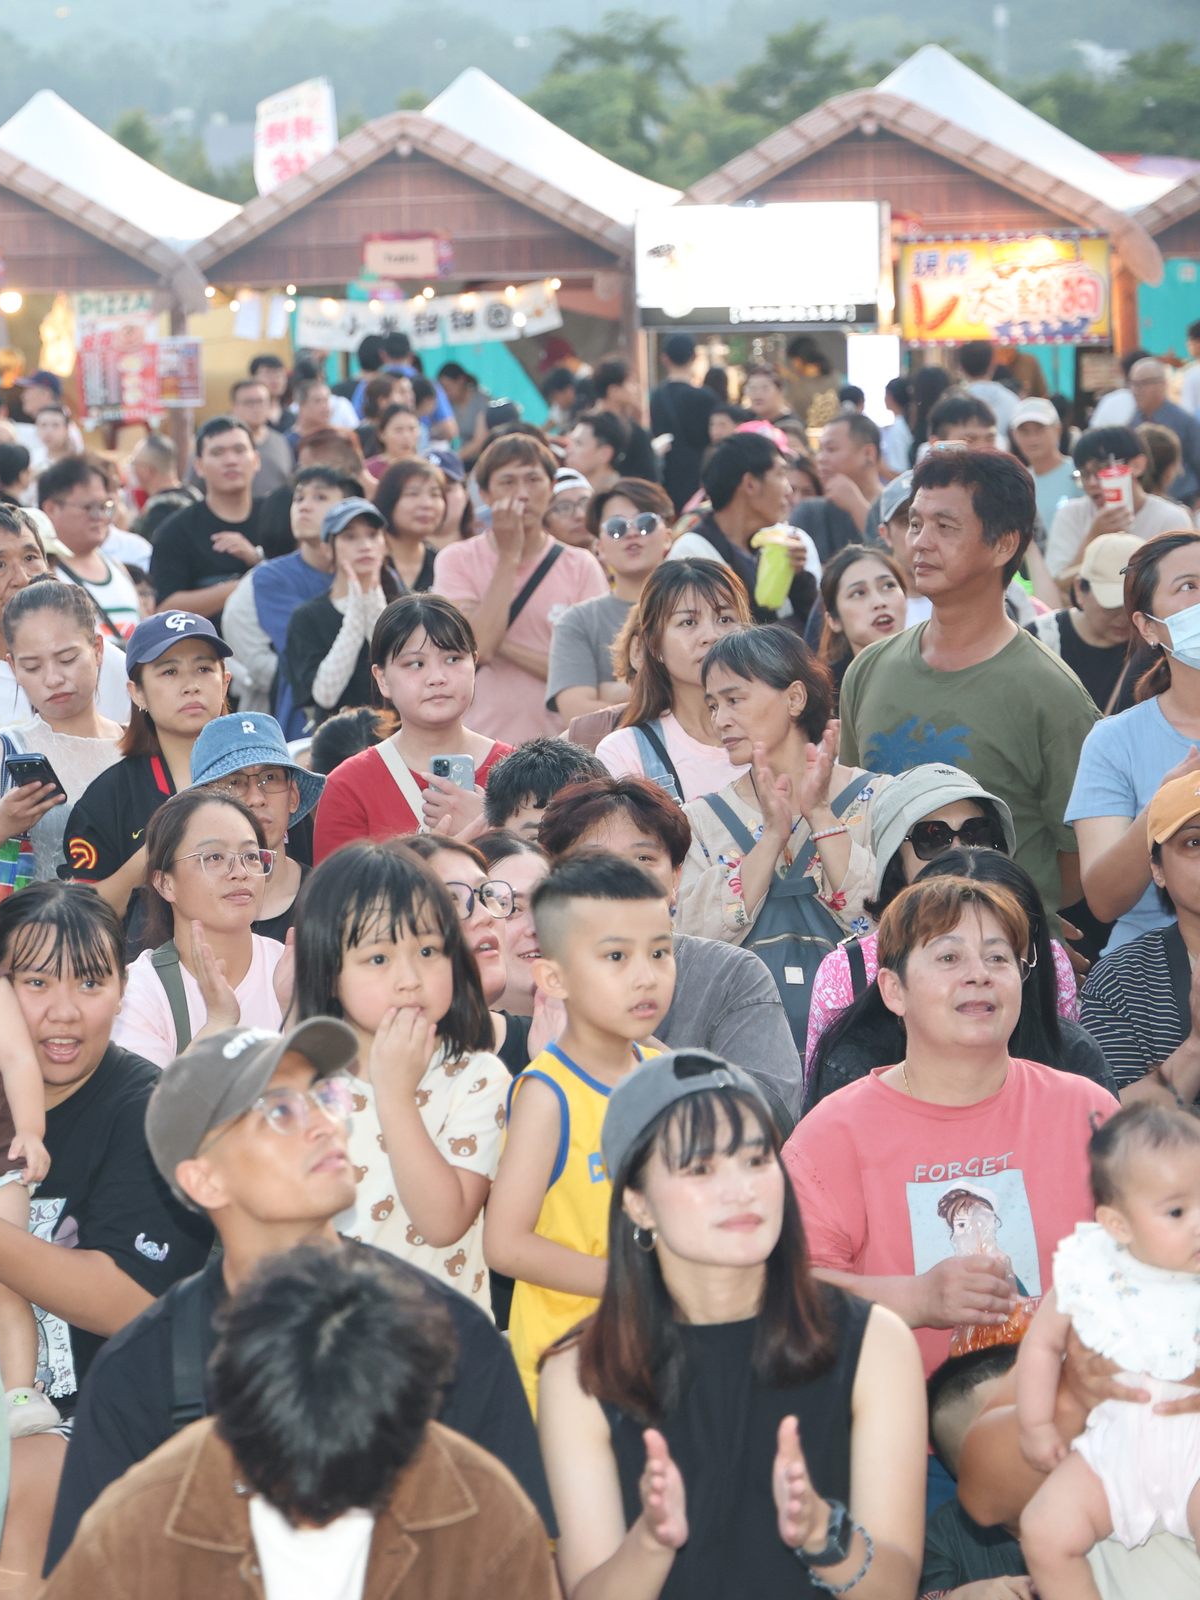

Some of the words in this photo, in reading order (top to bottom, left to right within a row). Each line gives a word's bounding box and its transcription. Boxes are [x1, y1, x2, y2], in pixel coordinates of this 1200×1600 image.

[78, 293, 152, 315] PIZZA
[241, 720, 257, 734] R
[914, 1151, 1014, 1182] FORGET
